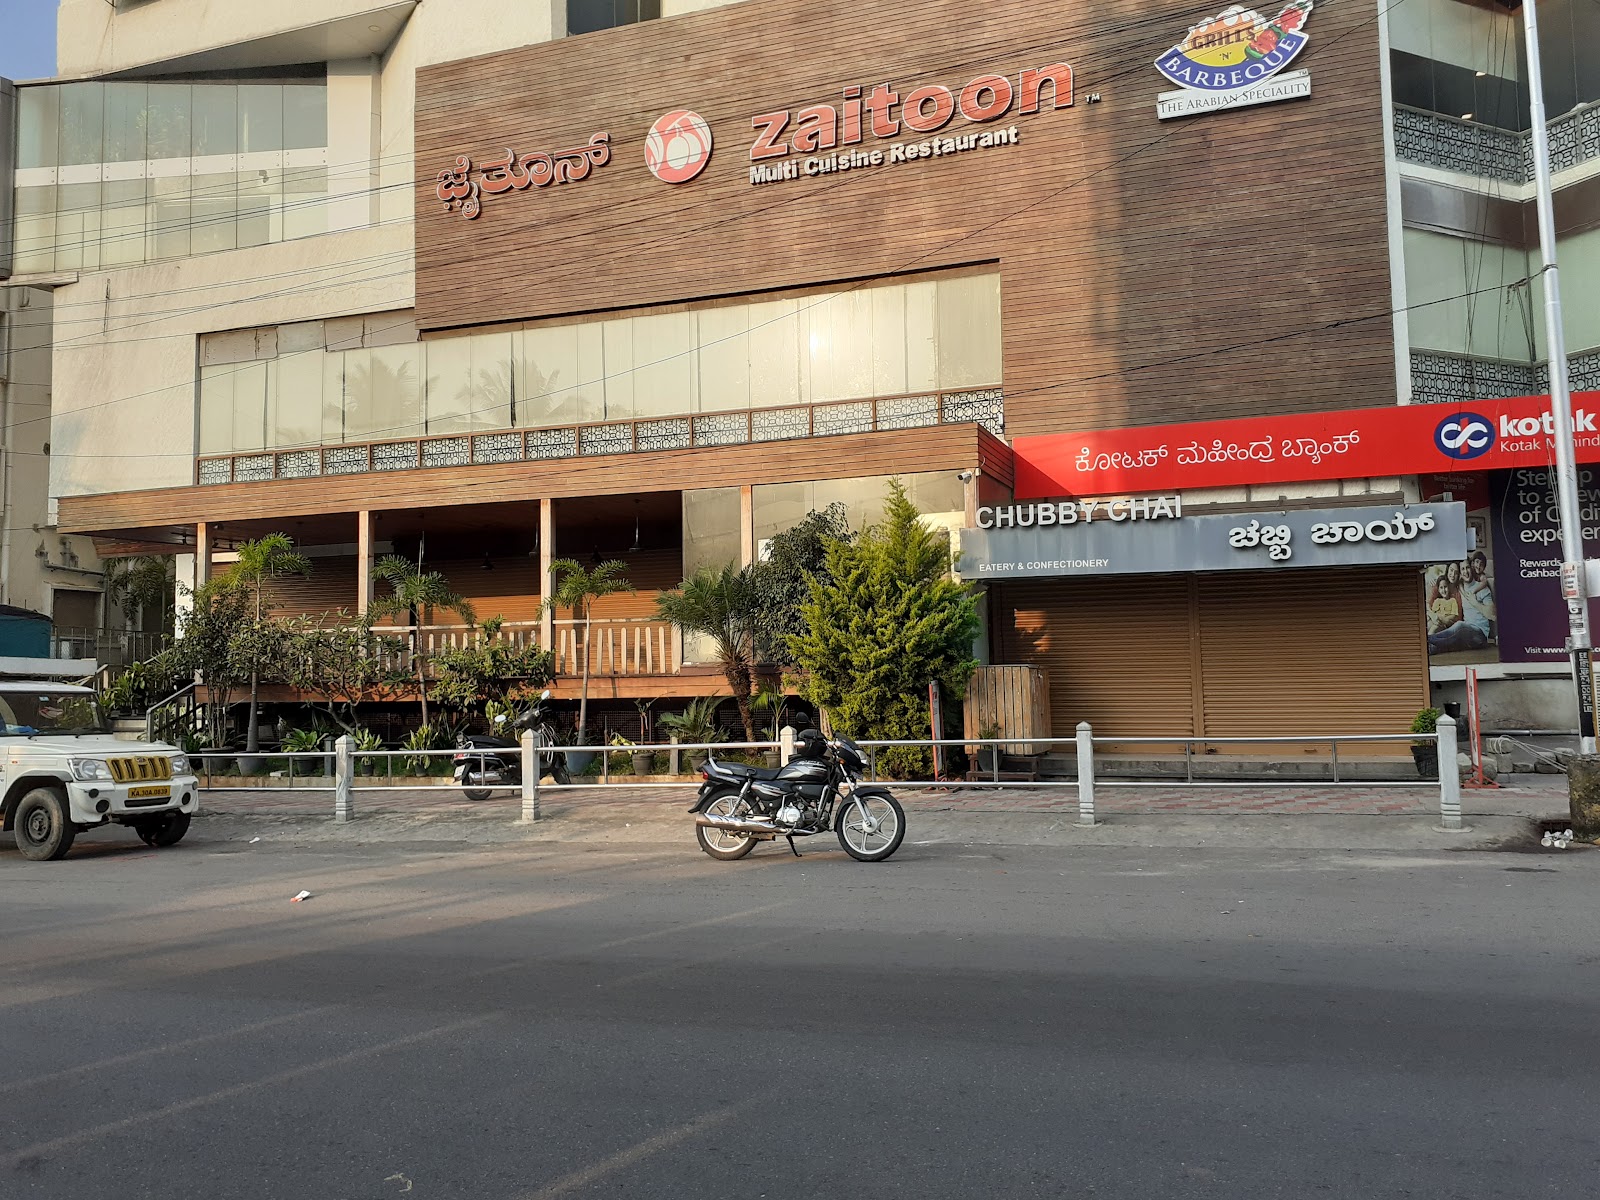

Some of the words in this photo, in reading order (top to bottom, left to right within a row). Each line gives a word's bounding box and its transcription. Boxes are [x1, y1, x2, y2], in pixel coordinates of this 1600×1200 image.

[1164, 38, 1297, 87] BARBEQUE
[749, 62, 1075, 160] zaitoon
[1159, 102, 1184, 114] THE
[1186, 93, 1238, 110] ARABIAN
[1242, 82, 1310, 101] SPECIALITY
[749, 158, 800, 185] Multi
[803, 149, 884, 177] Cuisine
[890, 125, 1019, 164] Restaurant
[1074, 444, 1168, 472] ಕೋಟಕ್
[1176, 435, 1275, 463] ಮಹೀಂದ್ರ
[1281, 429, 1360, 465] ಬ್ಯಾಂಕ್
[1500, 438, 1541, 453] Kotak
[975, 500, 1100, 529] CHUBBY
[1107, 495, 1182, 522] CHAI
[1517, 490, 1540, 505] to
[1577, 488, 1600, 502] ew
[1519, 505, 1541, 524] of
[1228, 519, 1292, 561] ಚಬ್ಬಿ
[1310, 511, 1435, 544] ಚಾಯ್
[979, 562, 1015, 572] EATERY
[1017, 562, 1025, 570] &
[1026, 558, 1109, 570] CONFECTIONERY
[1524, 646, 1542, 654] Visit
